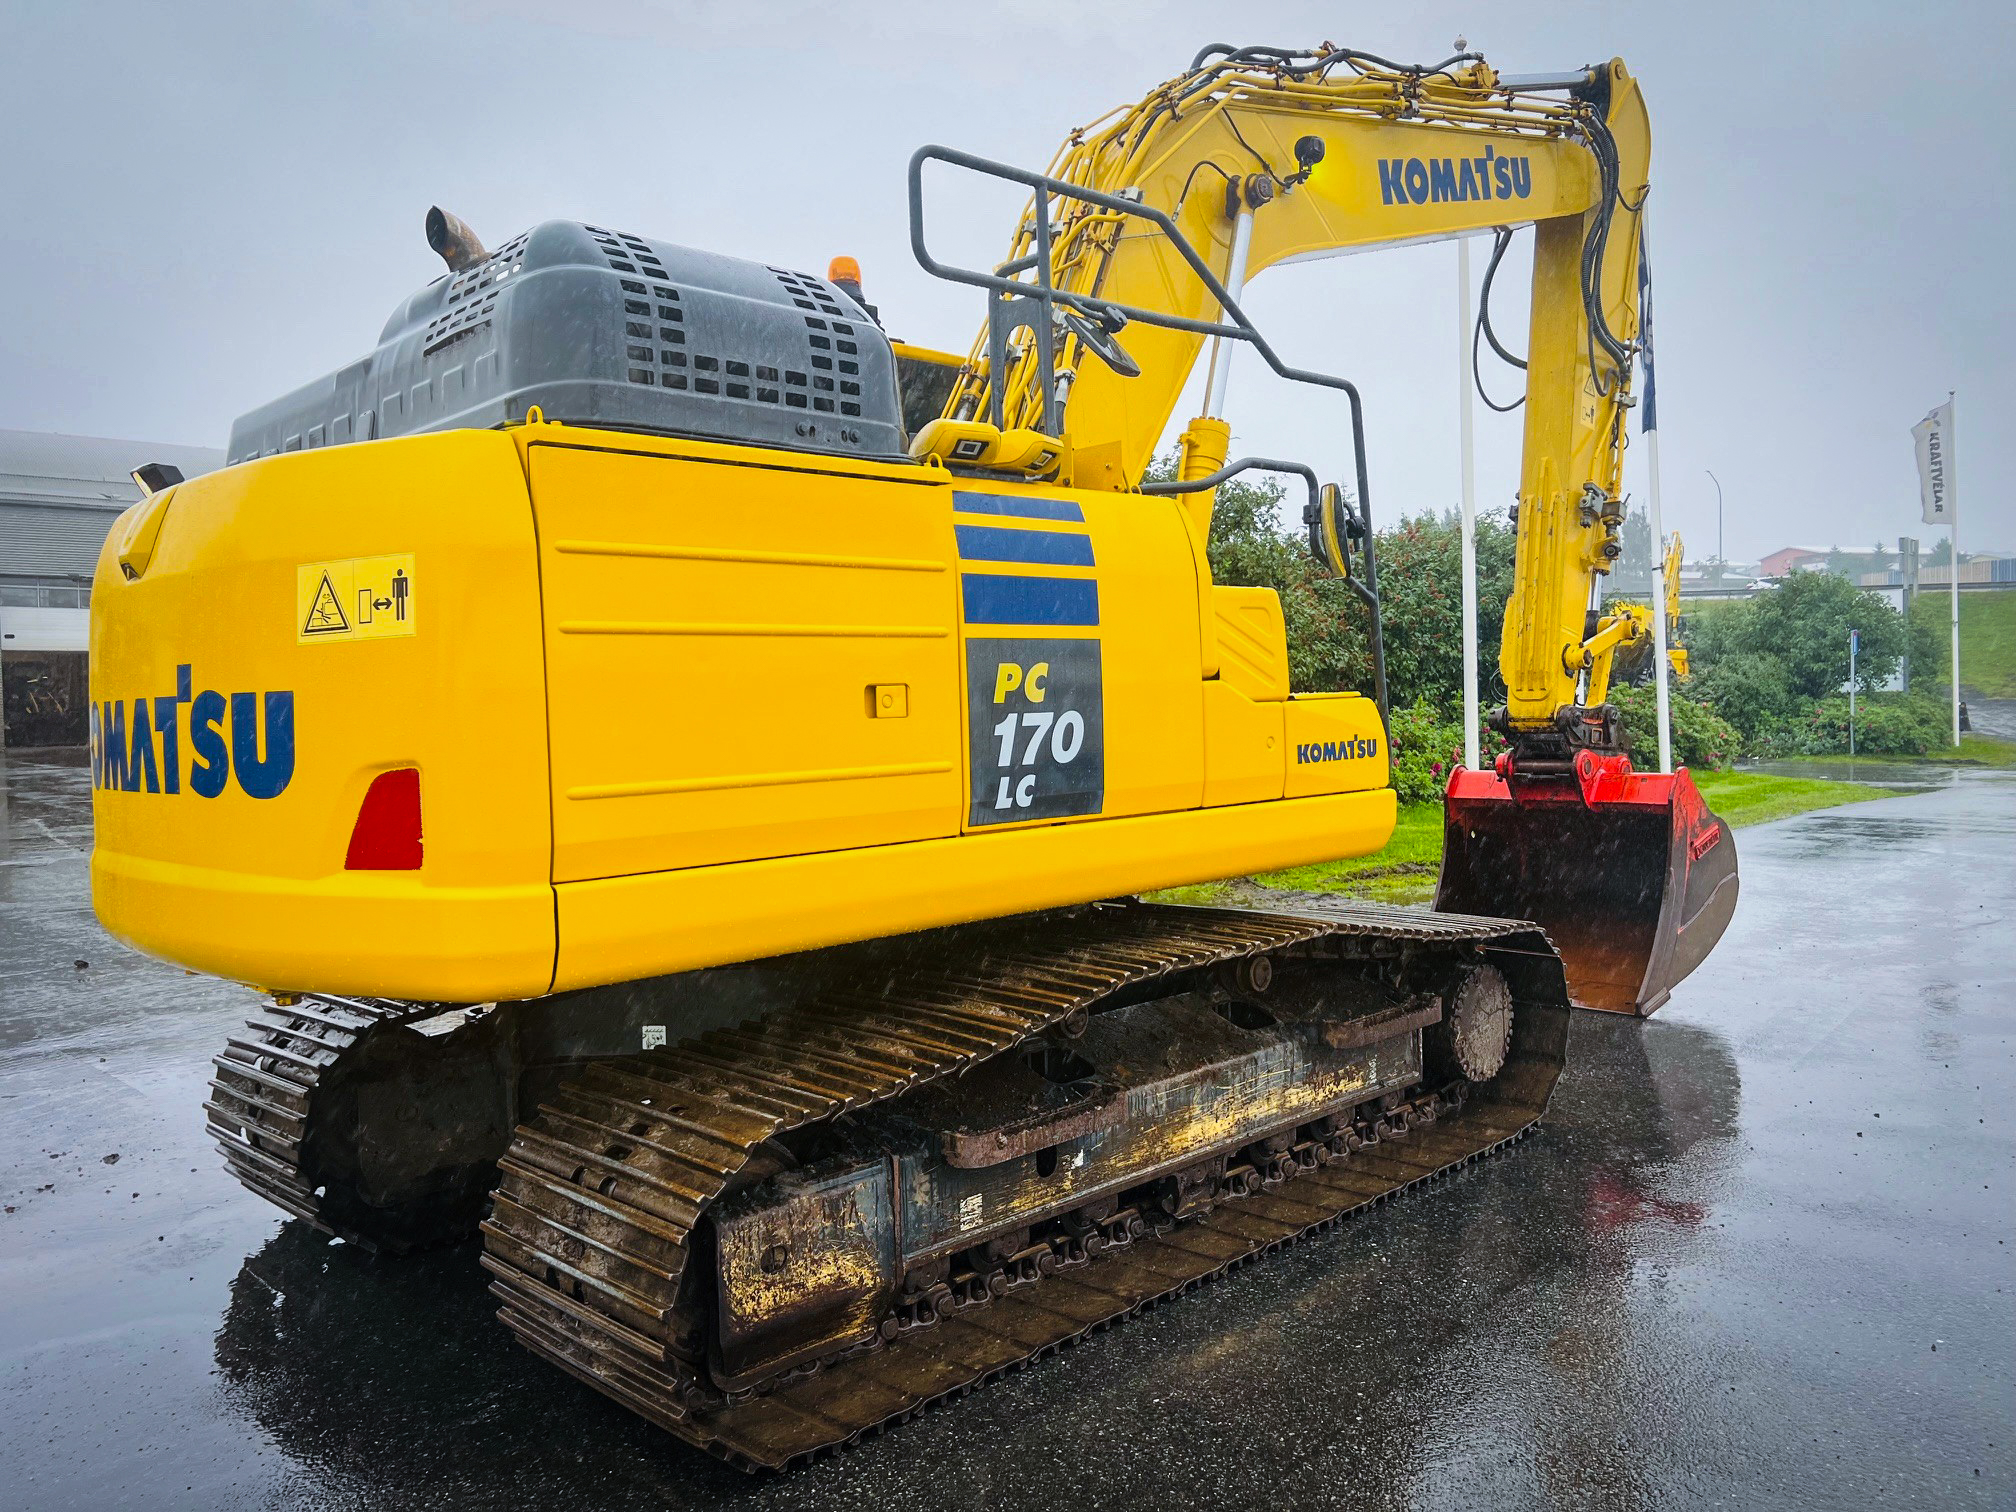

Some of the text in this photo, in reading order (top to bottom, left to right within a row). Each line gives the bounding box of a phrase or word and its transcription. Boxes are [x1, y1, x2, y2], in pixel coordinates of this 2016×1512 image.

[1377, 144, 1532, 206] KOMATSU
[1929, 431, 1946, 513] KRAFTVÉLAR
[993, 661, 1050, 704] PC
[90, 663, 296, 800] OMATSU
[993, 710, 1085, 767] 170
[1297, 733, 1377, 765] KOMATSU
[994, 773, 1037, 810] LC
